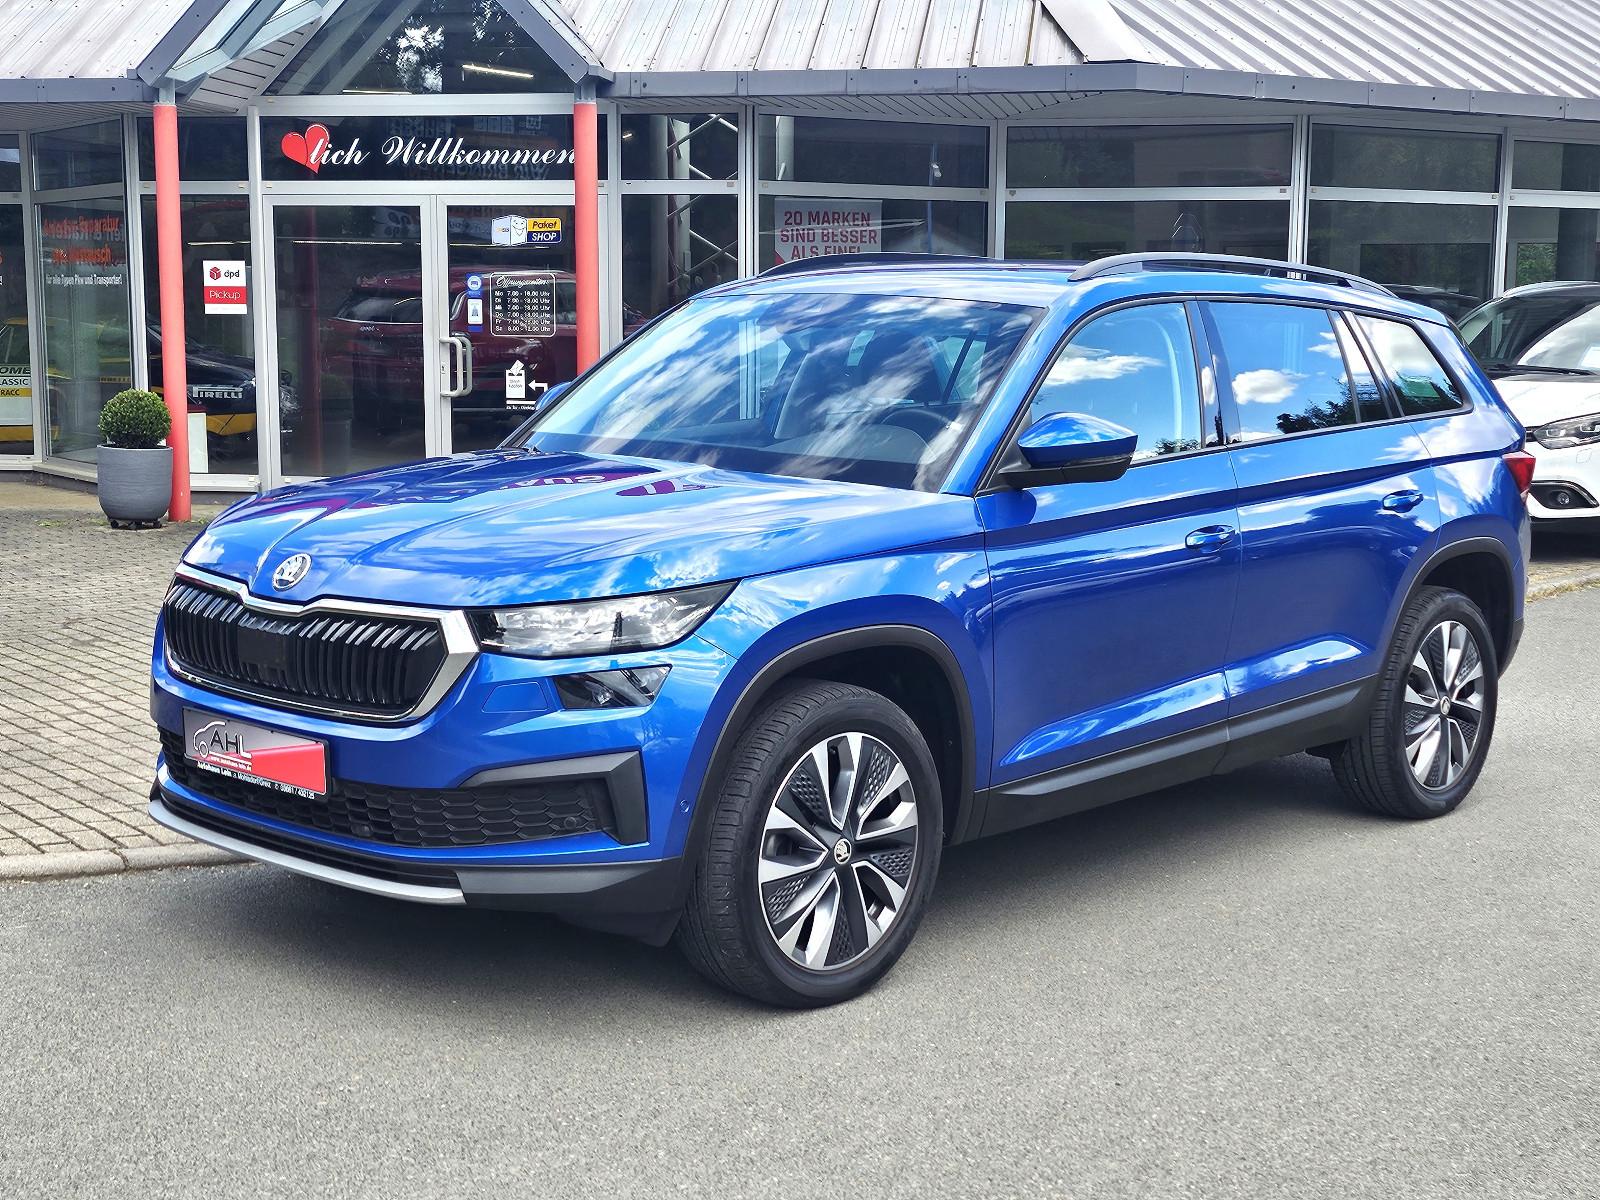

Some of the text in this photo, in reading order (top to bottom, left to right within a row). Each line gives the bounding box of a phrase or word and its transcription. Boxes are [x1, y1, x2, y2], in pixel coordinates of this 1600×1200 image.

[381, 136, 576, 166] Willkommen
[532, 220, 557, 229] Paket
[784, 210, 871, 227] 20 MARKEN
[531, 232, 557, 241] SHOP
[780, 227, 878, 244] SIND BESSER
[791, 245, 819, 260] ALS
[224, 269, 240, 279] dpd
[209, 290, 241, 301] Pickup
[192, 386, 243, 399] PIRELLI
[210, 728, 252, 758] AHL
